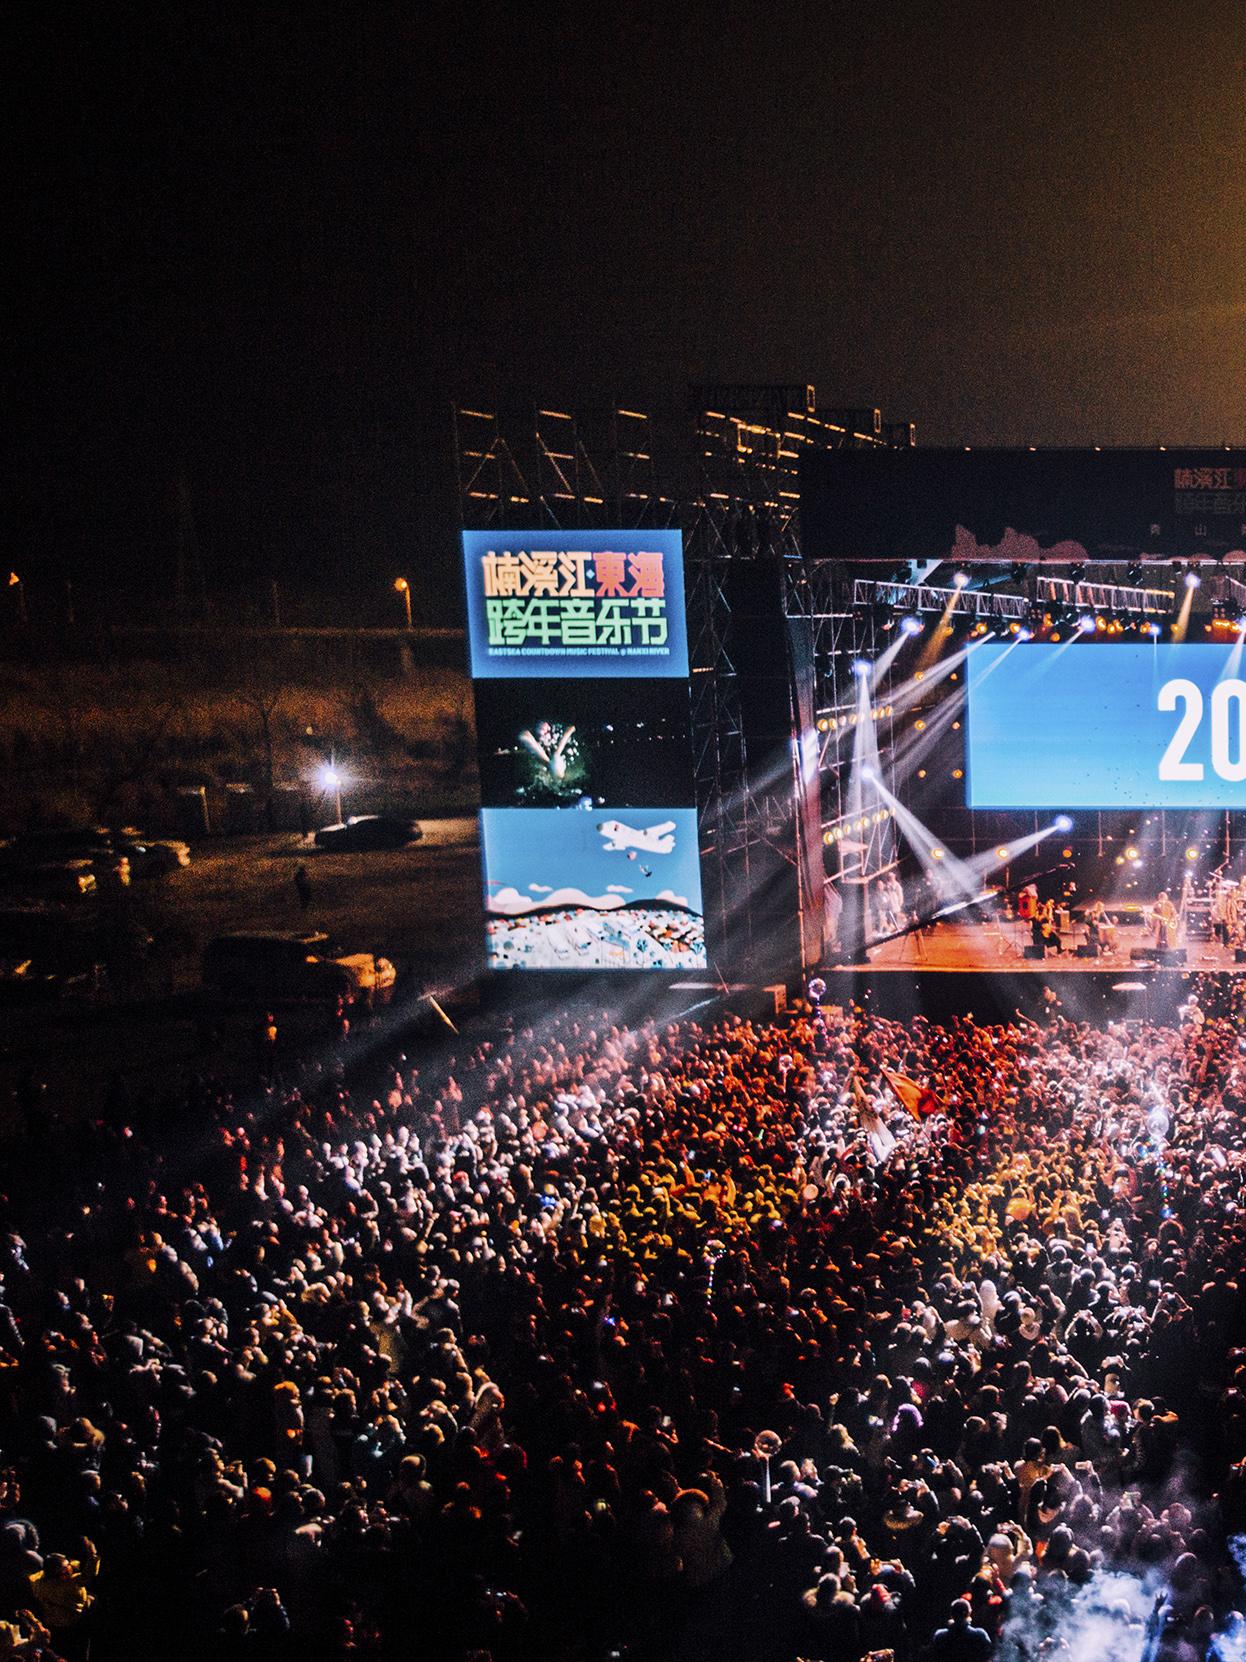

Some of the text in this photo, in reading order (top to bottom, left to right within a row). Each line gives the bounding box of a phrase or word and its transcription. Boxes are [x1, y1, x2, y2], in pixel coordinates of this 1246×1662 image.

[487, 598, 668, 645] 跨年音乐节
[588, 647, 619, 656] FESTIVAL
